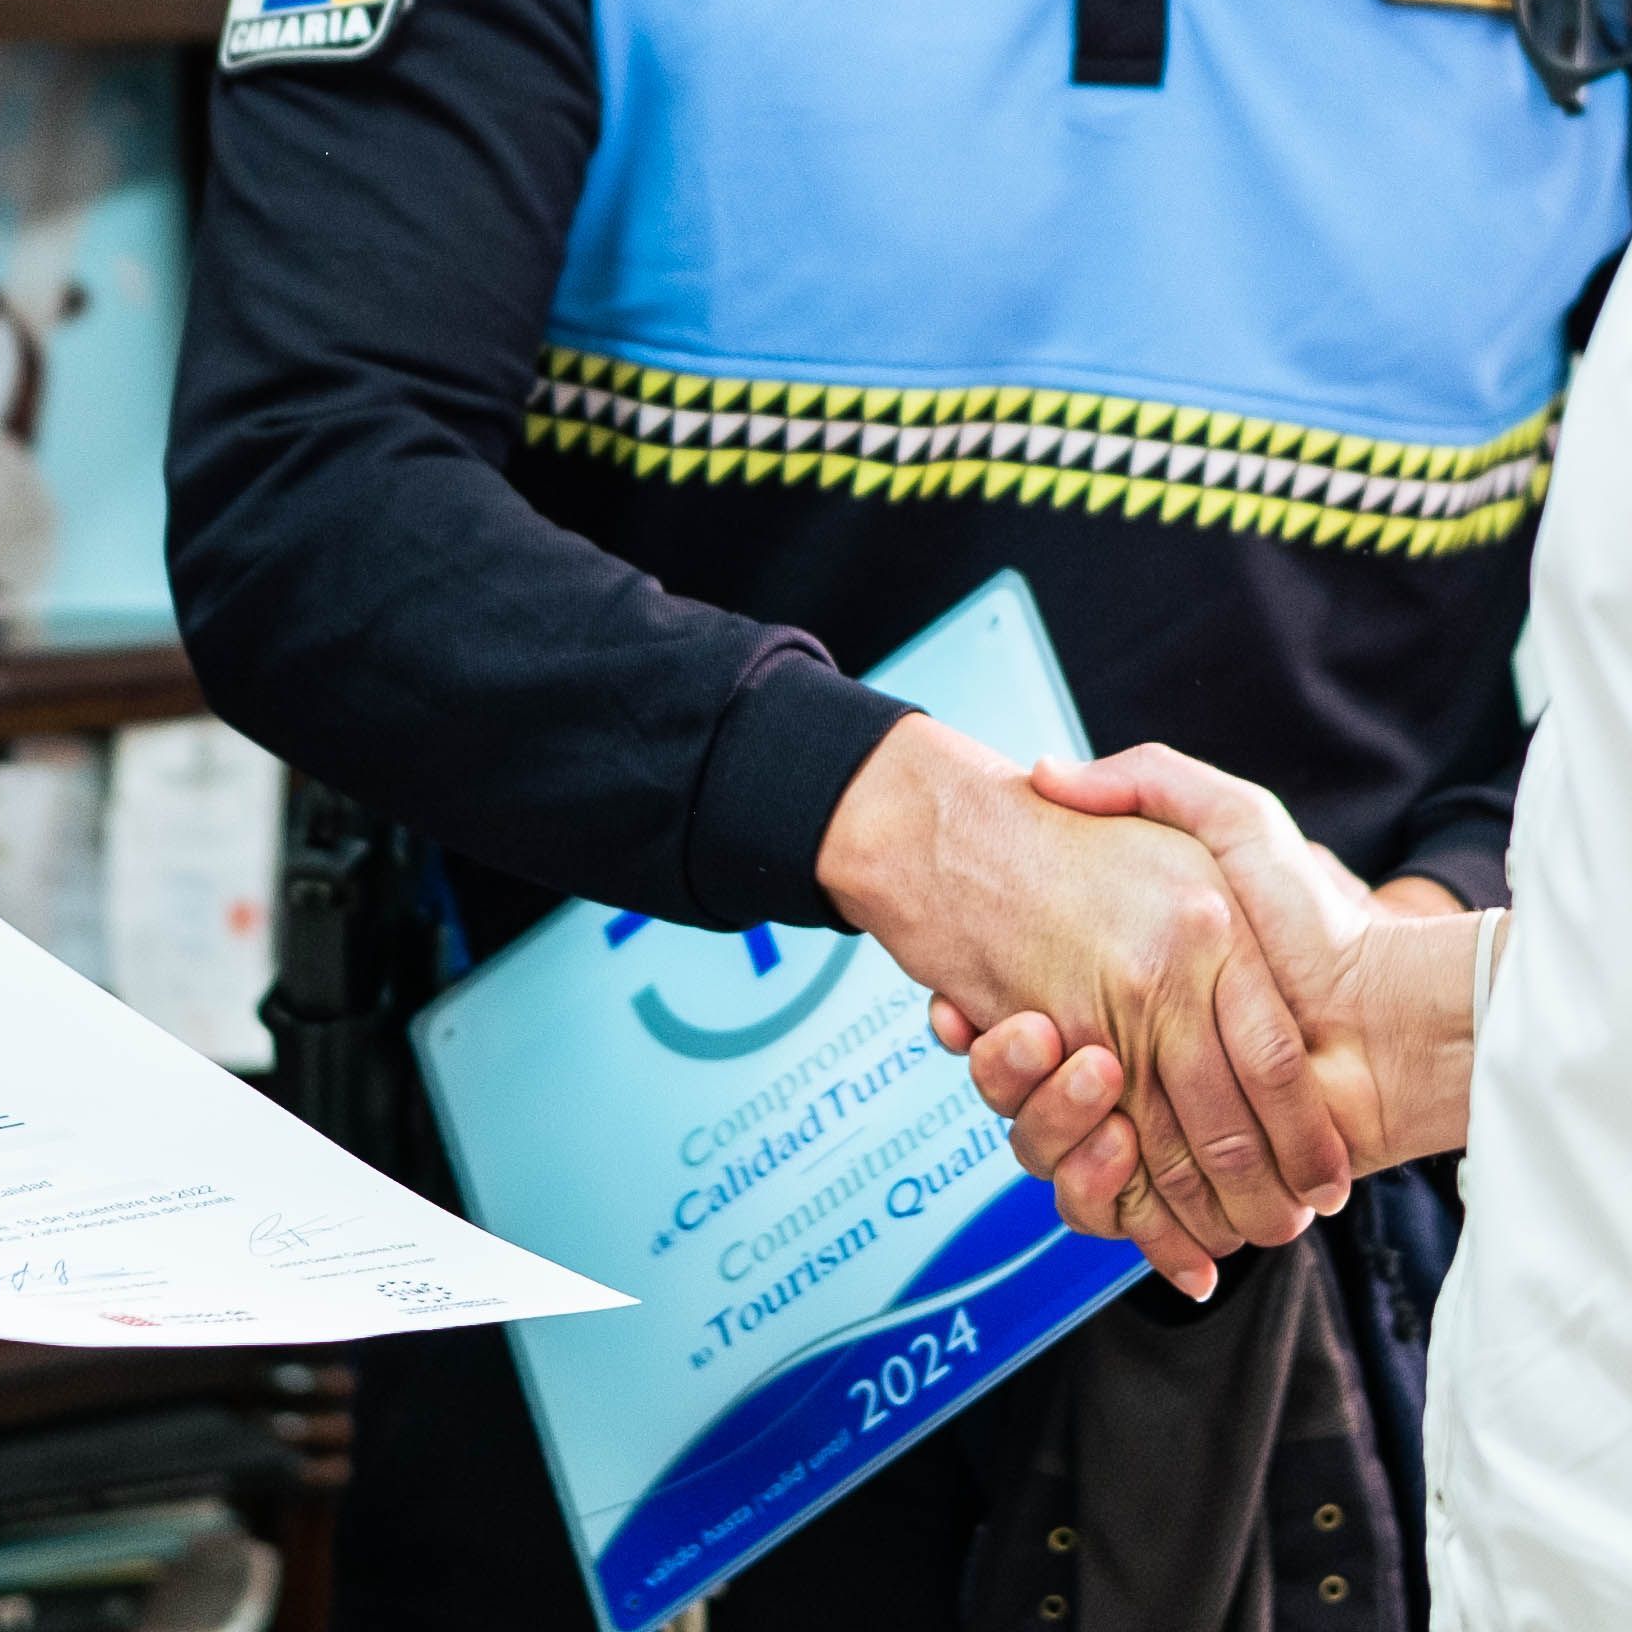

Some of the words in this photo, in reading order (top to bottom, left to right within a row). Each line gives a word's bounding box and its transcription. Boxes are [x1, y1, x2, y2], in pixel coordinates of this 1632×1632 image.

[674, 1102, 826, 1232] Calidad
[703, 1216, 881, 1349] Tourism
[884, 1115, 1013, 1219] Qualit
[846, 1305, 981, 1434] 2024
